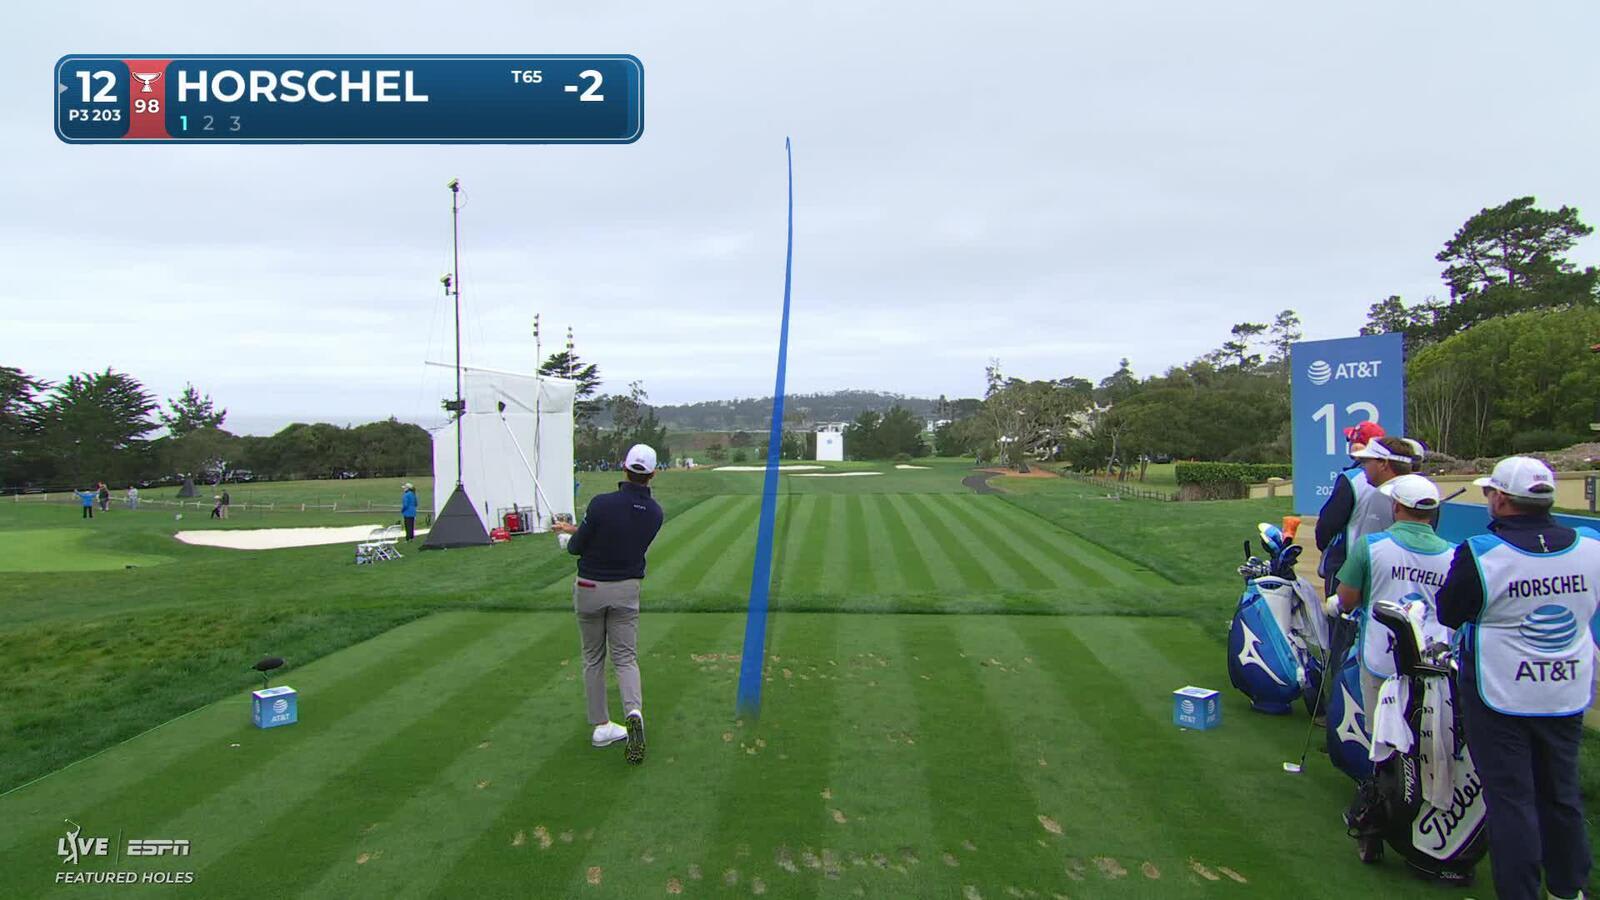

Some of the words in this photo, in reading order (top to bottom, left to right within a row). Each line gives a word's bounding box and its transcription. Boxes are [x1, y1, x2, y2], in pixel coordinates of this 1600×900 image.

[1335, 360, 1382, 380] AT&T
[1391, 565, 1446, 588] MITCHELL
[1508, 574, 1588, 598] HORSCHEL
[1515, 659, 1581, 682] AT&T
[1419, 772, 1484, 851] Titlei
